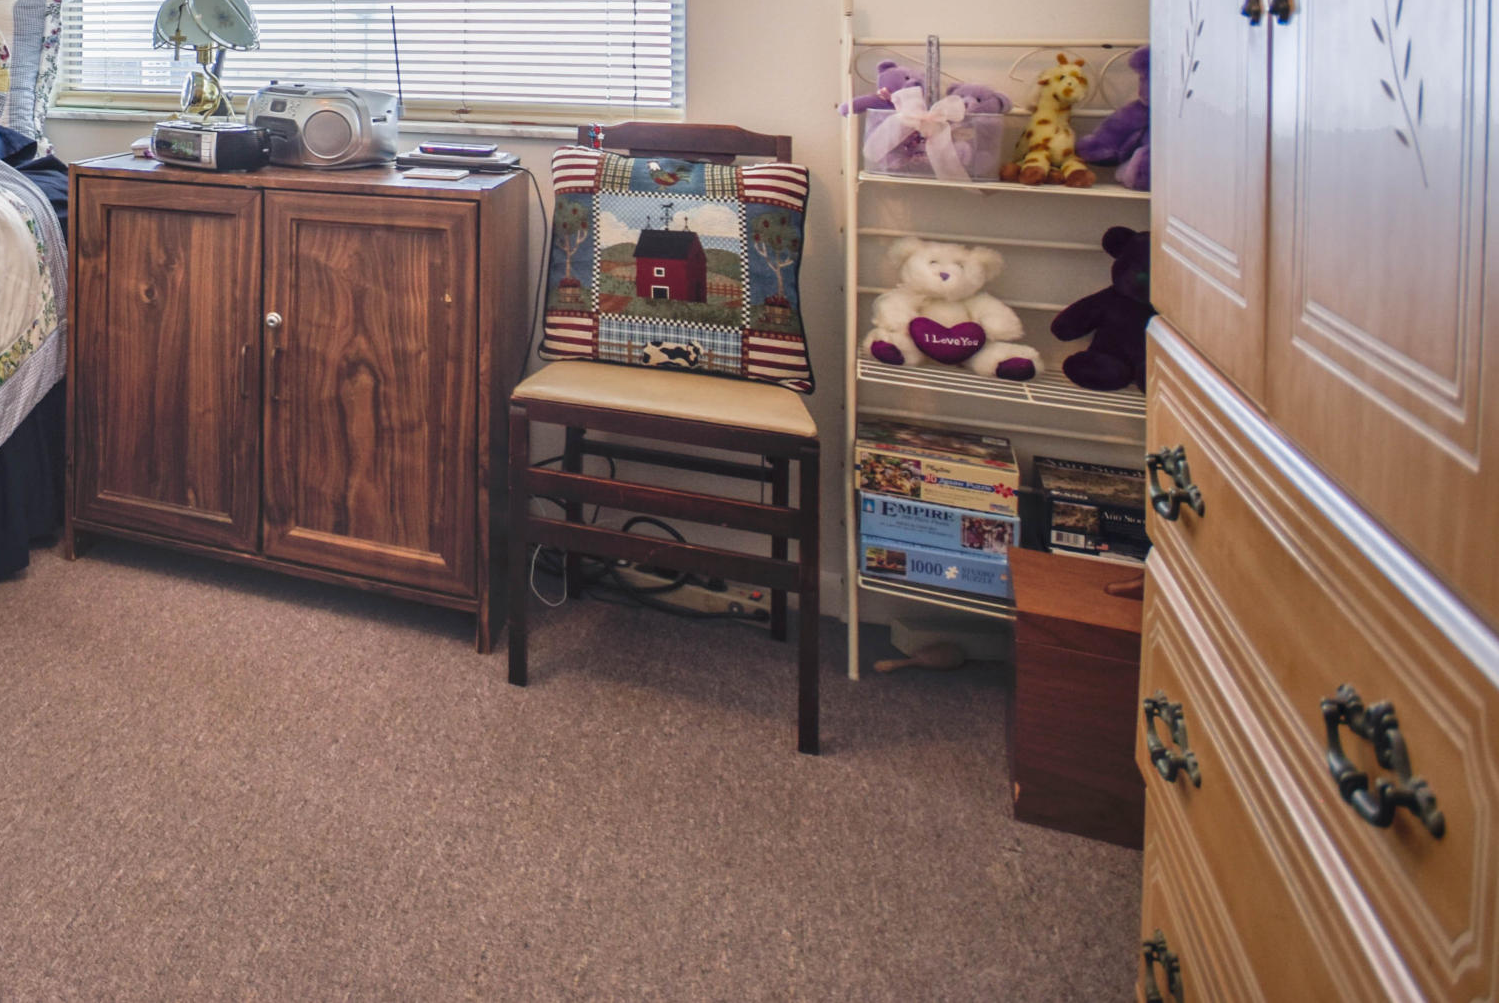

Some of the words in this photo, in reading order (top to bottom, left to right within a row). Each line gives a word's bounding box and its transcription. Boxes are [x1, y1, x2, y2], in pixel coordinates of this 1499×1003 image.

[924, 333, 930, 343] I
[932, 334, 960, 346] Love
[960, 336, 979, 346] You
[882, 501, 955, 522] EMPIRE
[910, 559, 943, 577] 1000
